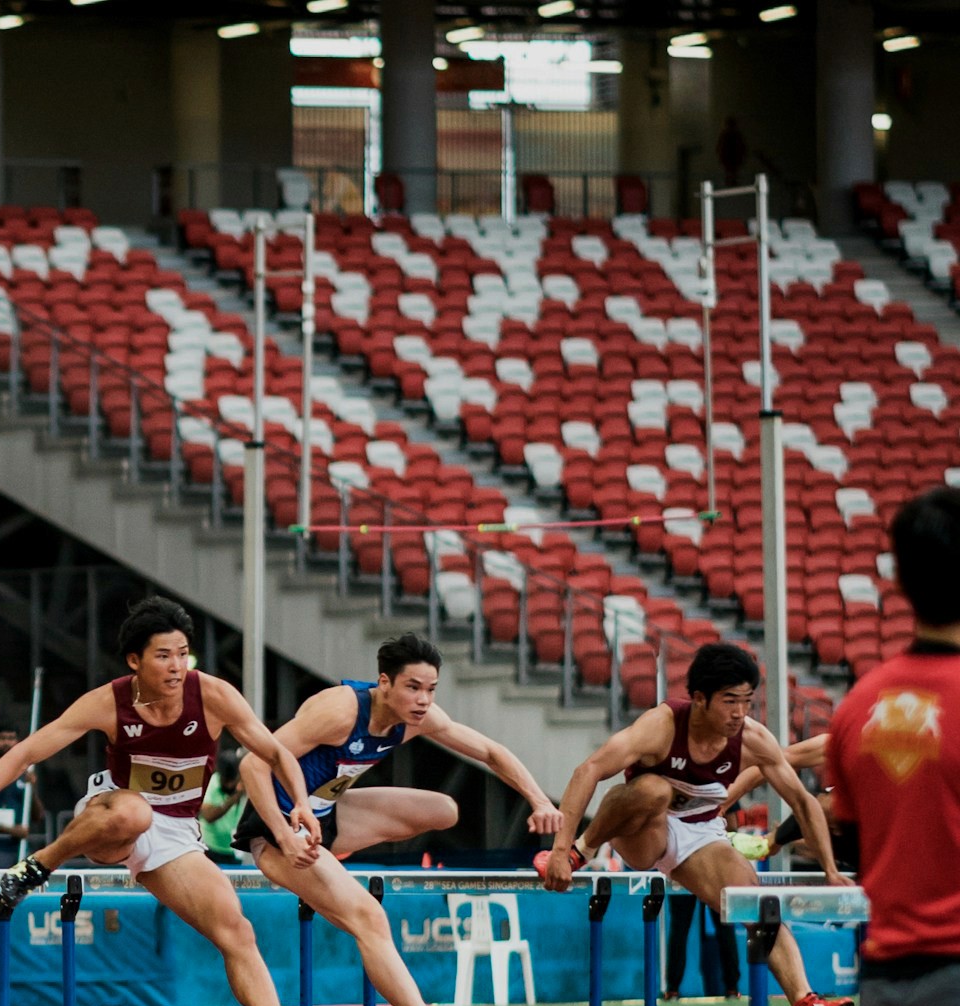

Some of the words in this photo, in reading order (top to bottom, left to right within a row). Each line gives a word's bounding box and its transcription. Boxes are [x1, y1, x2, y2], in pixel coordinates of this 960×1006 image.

[123, 724, 143, 737] W
[671, 756, 686, 770] W
[151, 770, 185, 792] 90
[441, 881, 456, 890] SEA
[457, 881, 486, 890] GAMES
[487, 881, 535, 890] SINGAPORE
